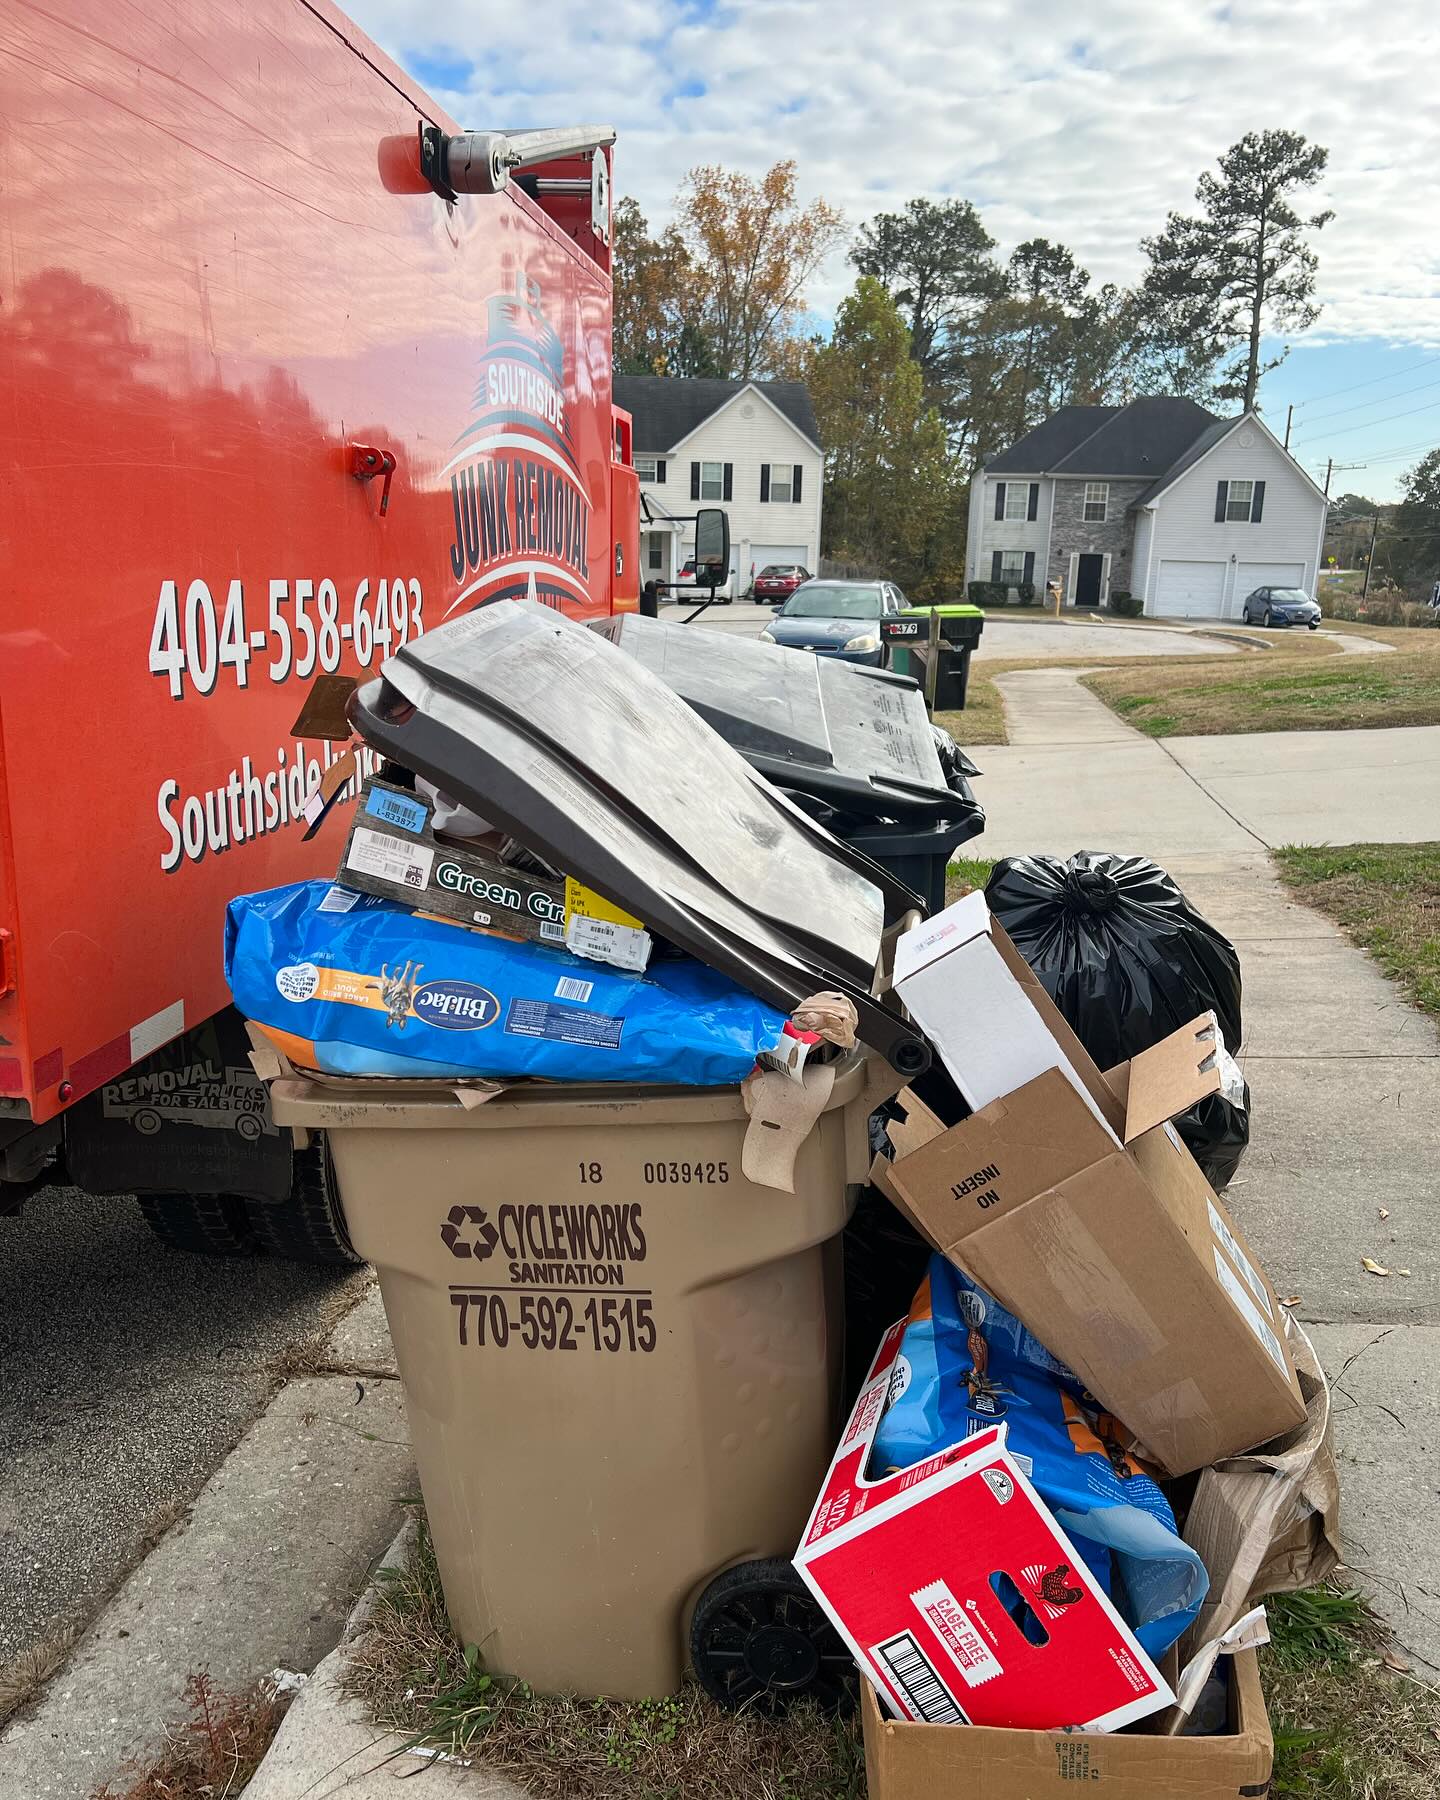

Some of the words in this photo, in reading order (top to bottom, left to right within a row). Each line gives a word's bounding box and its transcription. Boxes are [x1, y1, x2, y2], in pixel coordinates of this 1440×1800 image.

[488, 363, 564, 434] SOUTHSIDE
[450, 459, 512, 585] JUNK
[514, 459, 590, 585] REMOVAL
[149, 577, 425, 698] 404-558-6493
[376, 808, 417, 829] L-833877
[436, 861, 522, 910] Green
[527, 891, 566, 924] Gr
[102, 1060, 222, 1104] REMOVAL
[150, 1093, 181, 1108] FOR
[198, 1082, 264, 1101] TRUCKS
[579, 1162, 603, 1184] 18
[644, 1162, 729, 1184] 0039425
[950, 1163, 1001, 1201] INSERT
[976, 1189, 1001, 1210] NO
[498, 1203, 647, 1261] CYCLEWORKS
[509, 1263, 624, 1285] SANITATION
[450, 1294, 657, 1353] 770-592-1515
[928, 1607, 945, 1628] GRADE
[936, 1596, 967, 1632] CAGE
[957, 1629, 989, 1666] FREE
